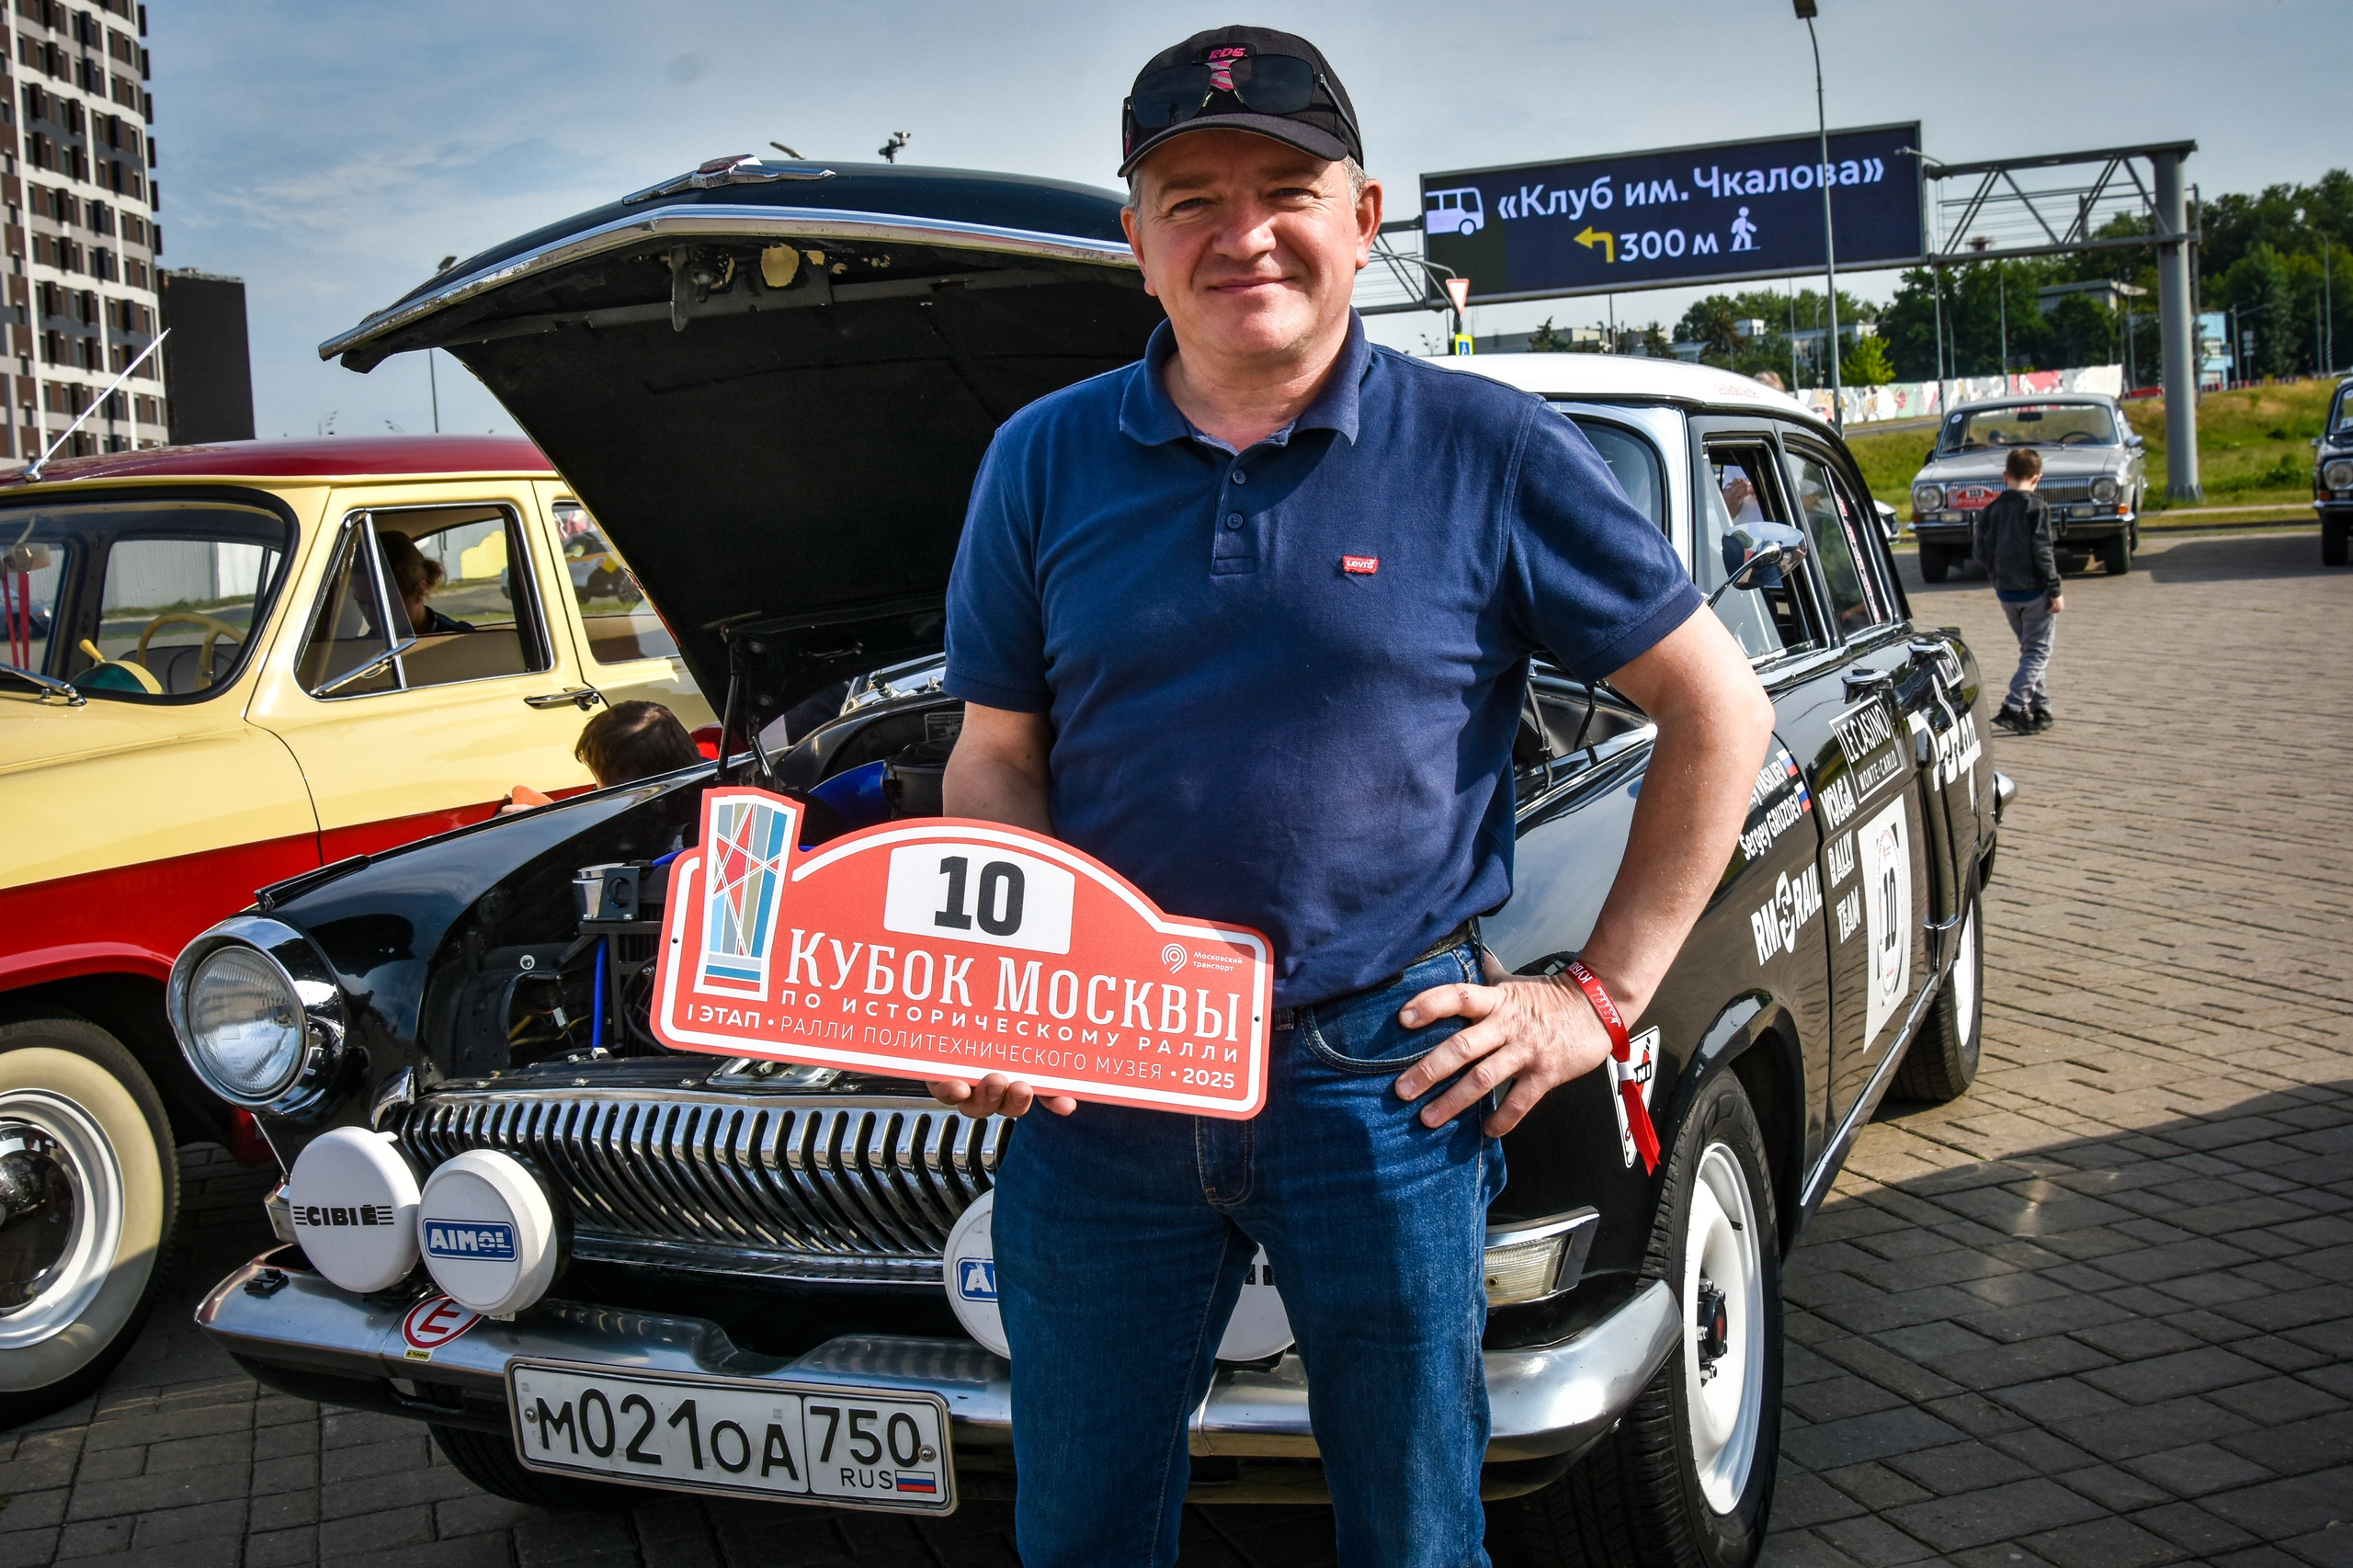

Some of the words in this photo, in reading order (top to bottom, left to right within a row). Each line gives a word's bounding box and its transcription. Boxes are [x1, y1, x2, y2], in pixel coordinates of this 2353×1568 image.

[1497, 175, 1614, 221] «Клуб
[1624, 179, 1689, 208] им.
[1693, 157, 1885, 199] Чкалова»
[1620, 228, 1686, 262] 300
[1692, 233, 1720, 256] м
[1836, 722, 1860, 764] LE
[1848, 704, 1892, 756] CASINO
[1755, 759, 1789, 797] VASILIEV
[1818, 775, 1857, 831] VOLGA
[1738, 821, 1773, 860] Sergey
[1766, 791, 1803, 838] GRUZDEV
[1827, 829, 1856, 889] RALLY
[933, 855, 1026, 938] 10
[1836, 885, 1862, 944] TEAM
[1883, 866, 1897, 953] 10
[783, 927, 975, 1008] КУБОК
[993, 956, 1241, 1042] МОСКВЫ
[1192, 960, 1234, 972] транспорт
[1193, 950, 1243, 965] Московский
[1566, 960, 1594, 984] КУБО
[687, 1003, 694, 1020] I
[699, 1005, 761, 1029] ЭТАП
[780, 1015, 855, 1041] РАЛЛИ
[863, 1026, 1087, 1071] ПОЛИТЕХНИЧЕСКОГО
[1095, 1056, 1163, 1081] МУЗЕЯ
[1182, 1066, 1235, 1090] 2025
[780, 989, 822, 1009] ПО
[842, 996, 1120, 1048] ИСТОРИЧЕСКОМУ
[1138, 1036, 1239, 1063] РАЛЛИ
[306, 1204, 379, 1227] CIBIÉ
[429, 1228, 512, 1253] AIMOL
[417, 1298, 461, 1335] E
[809, 1405, 921, 1469] 750
[840, 1469, 894, 1490] RUS
